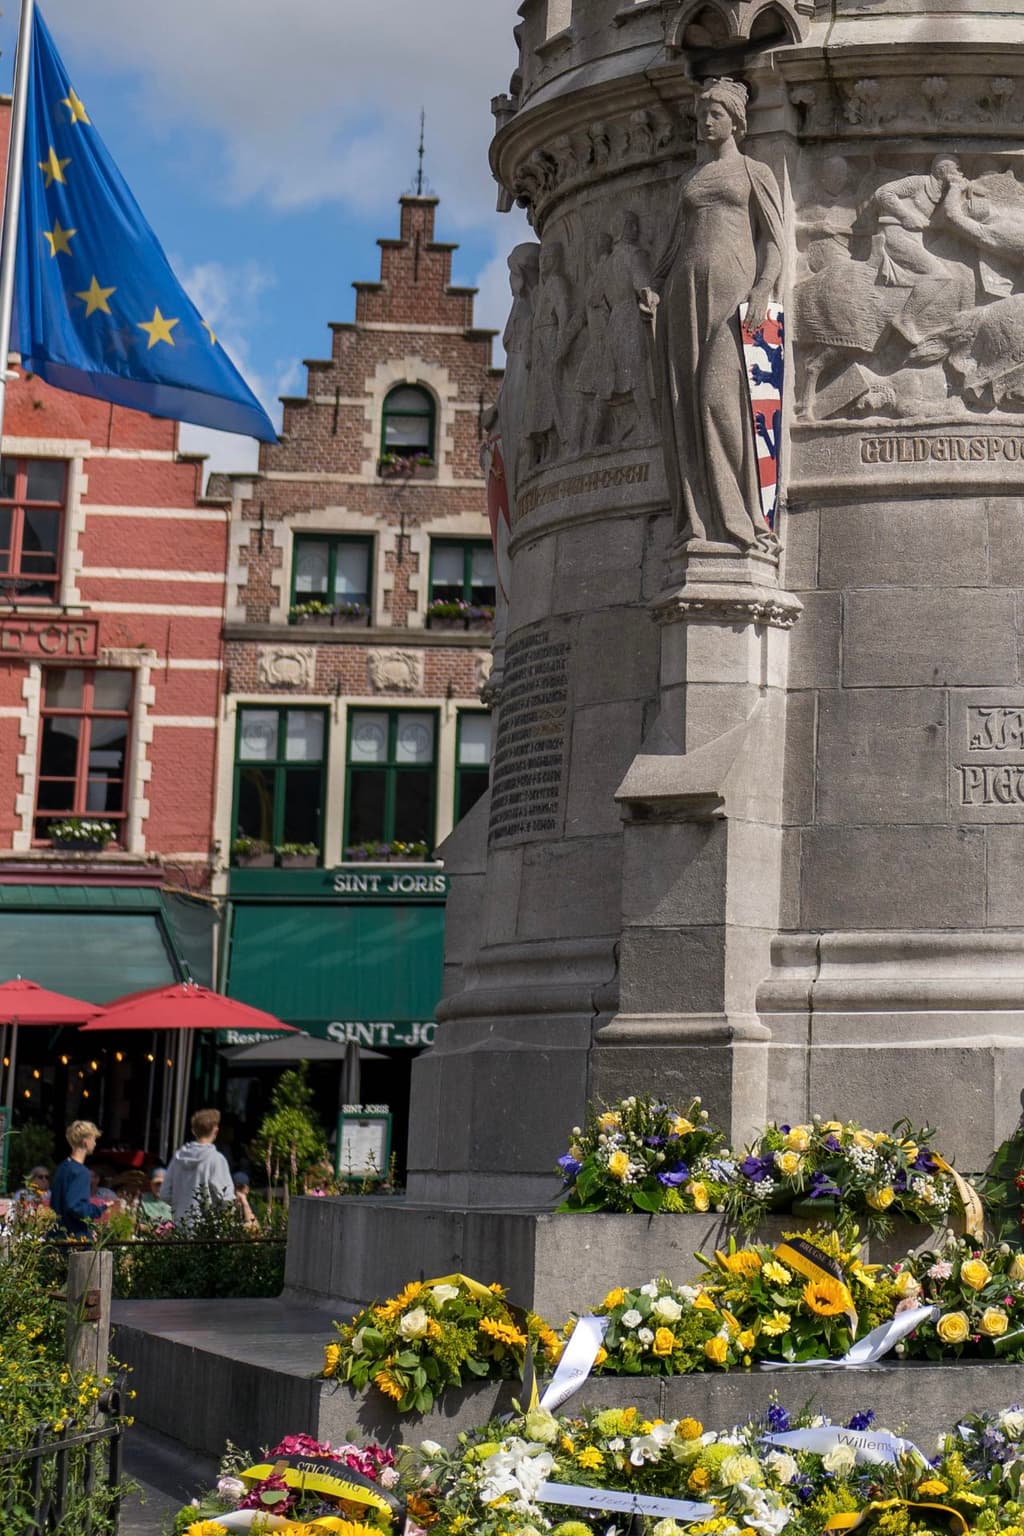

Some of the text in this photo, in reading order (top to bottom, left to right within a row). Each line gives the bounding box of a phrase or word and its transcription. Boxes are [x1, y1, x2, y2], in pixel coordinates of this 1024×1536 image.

[333, 873, 447, 893] SINT JORIS
[342, 1103, 363, 1114] SINT
